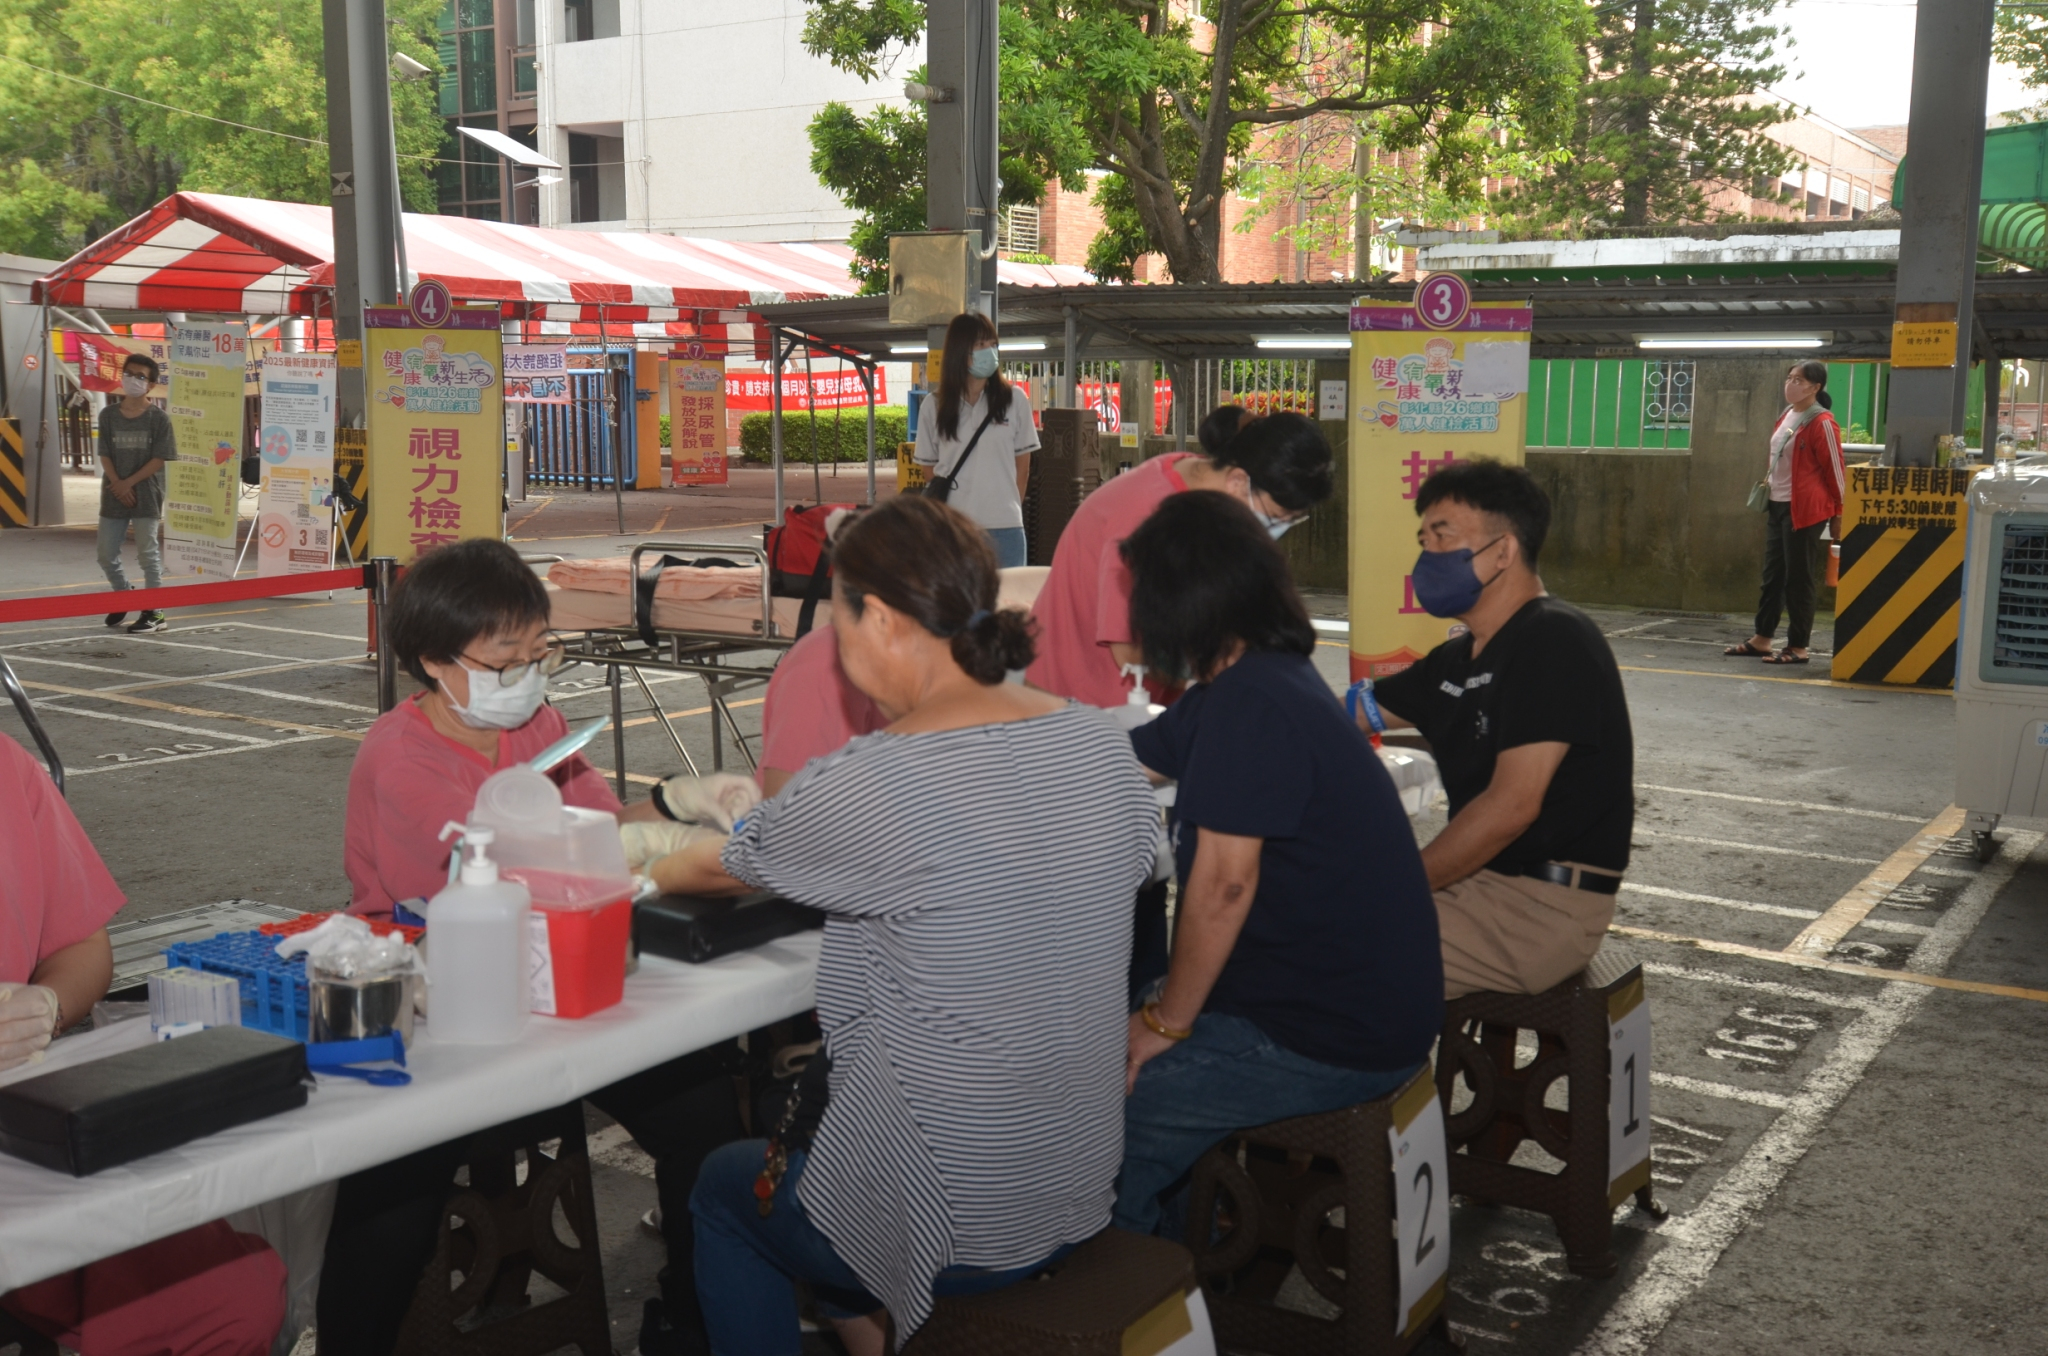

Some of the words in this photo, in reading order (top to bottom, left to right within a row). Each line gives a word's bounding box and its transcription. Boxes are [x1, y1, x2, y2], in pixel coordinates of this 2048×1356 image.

[421, 289, 437, 320] 4
[1432, 284, 1452, 321] 3
[211, 333, 245, 353] 18萬
[1907, 336, 1940, 345] 請勿停車
[693, 345, 700, 357] 7
[263, 355, 336, 369] 2025最新健康資訊
[323, 395, 329, 413] 1
[405, 398, 481, 413] 萬人健檢活動
[681, 395, 698, 449] 發放及解說
[698, 396, 715, 448] 採尿管
[1399, 416, 1498, 433] 萬人健檢活動
[261, 475, 269, 492] 2
[1852, 467, 1970, 497] 汽車停車時間
[1861, 499, 1957, 515] 下午5:30前駛離
[299, 529, 307, 546] 3
[1704, 1006, 1820, 1065] 166
[1624, 1052, 1640, 1138] 1
[1413, 1162, 1436, 1268] 2
